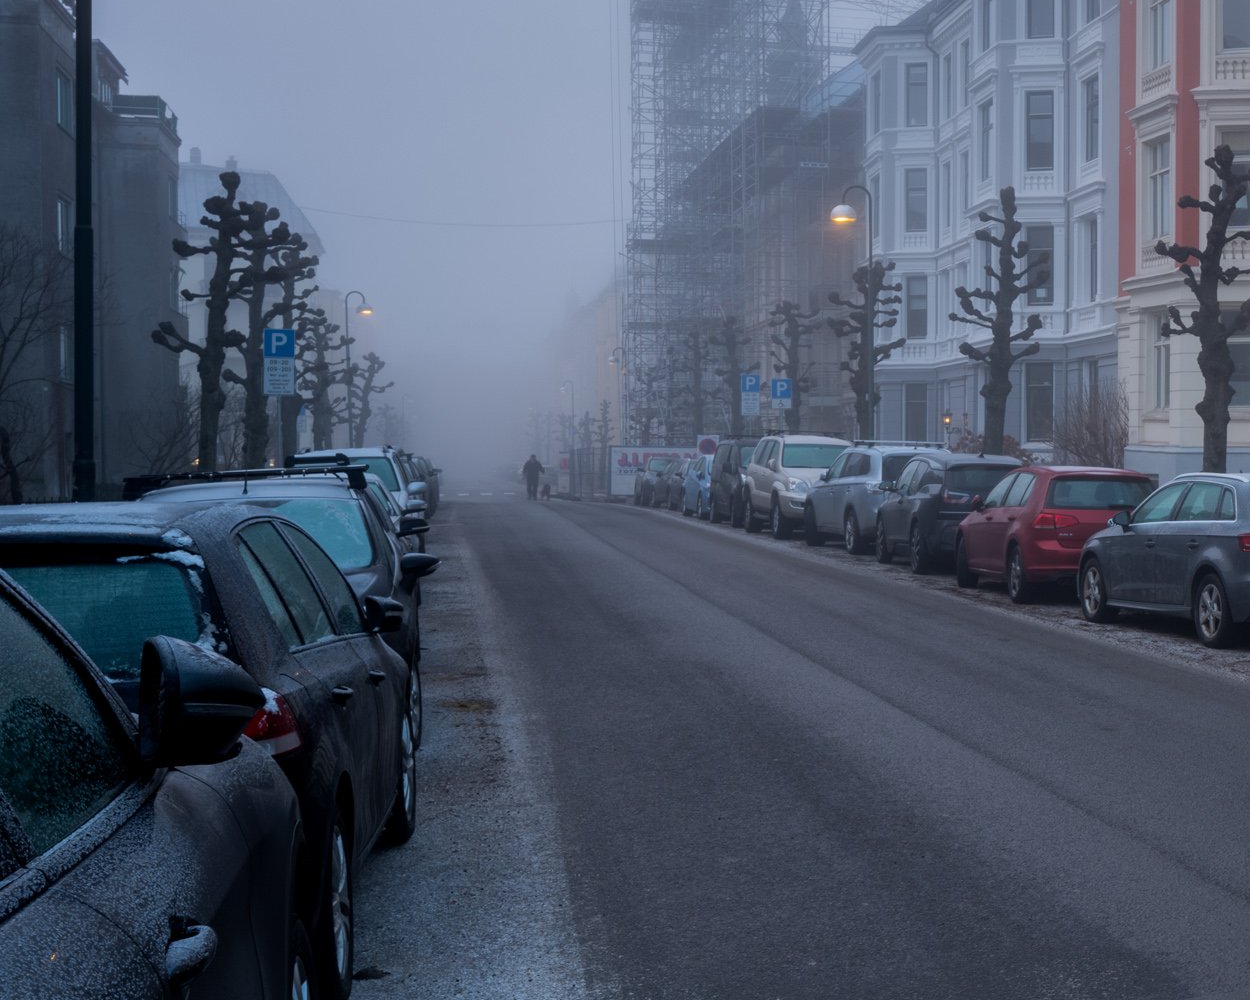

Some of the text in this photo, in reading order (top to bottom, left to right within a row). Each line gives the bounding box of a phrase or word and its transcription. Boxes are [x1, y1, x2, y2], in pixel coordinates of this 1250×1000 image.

[271, 332, 288, 354] P
[746, 376, 756, 390] P
[777, 381, 788, 397] P
